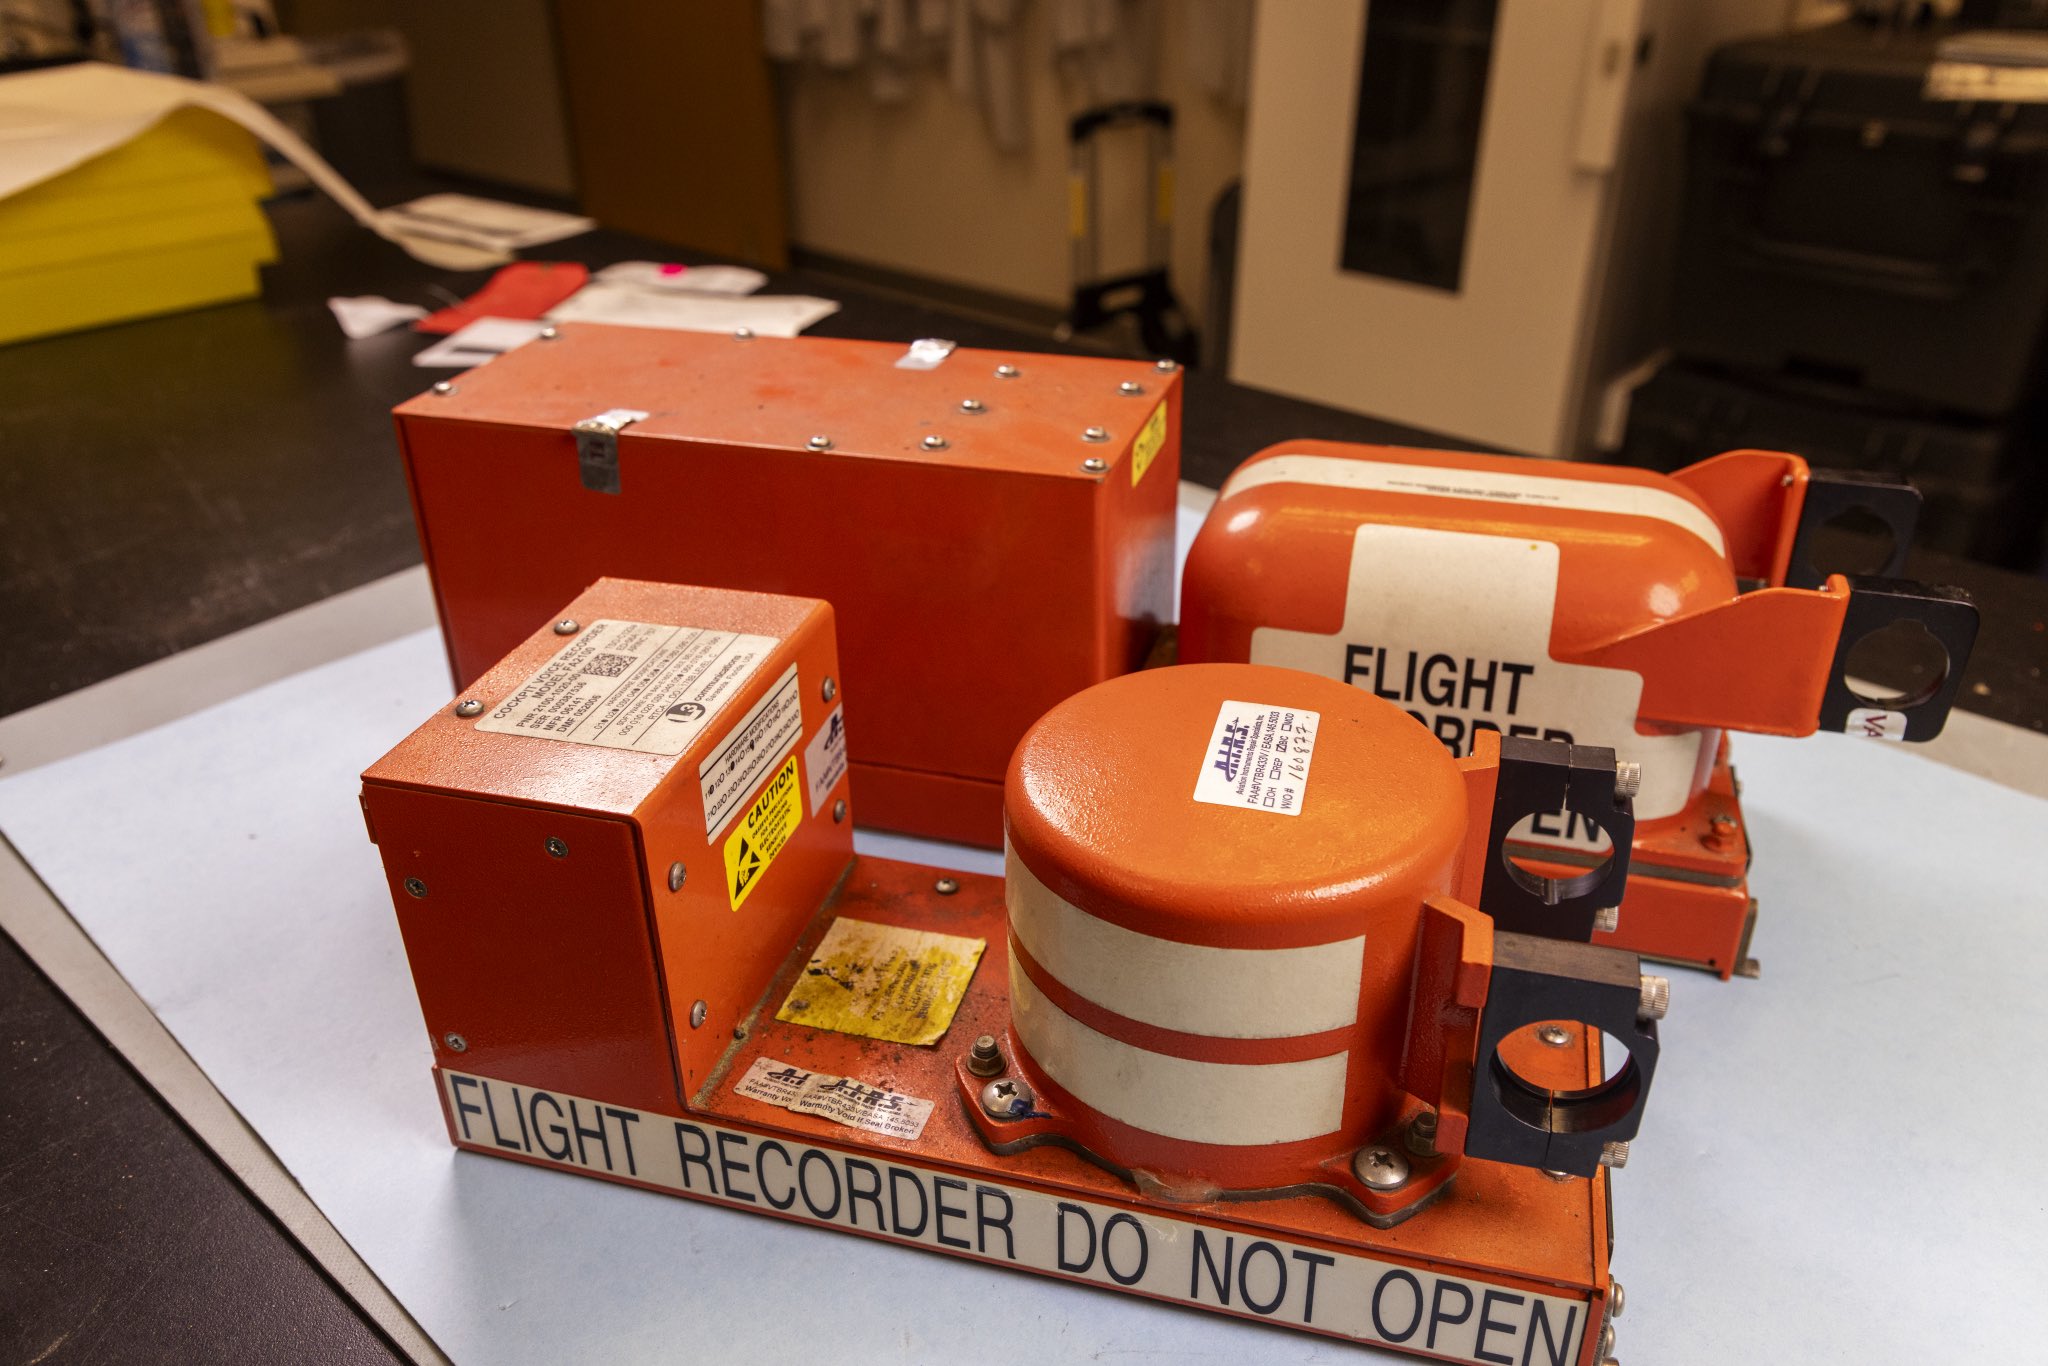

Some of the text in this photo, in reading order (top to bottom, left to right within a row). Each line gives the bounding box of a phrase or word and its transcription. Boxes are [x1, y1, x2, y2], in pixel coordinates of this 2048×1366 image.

[493, 624, 604, 719] COCKPIT VOICE RECORDER
[531, 647, 595, 698] MODEL FA2100
[694, 655, 741, 701] communications
[1344, 644, 1534, 715] FLIGHT
[516, 713, 537, 727] PNR
[529, 715, 550, 728] SER
[542, 715, 564, 730] MFR
[556, 717, 575, 732] DMF
[725, 700, 779, 763] HARDWARE MODIFICATIONS
[1247, 739, 1257, 751] Repair
[1240, 751, 1254, 776] Instruments
[1266, 786, 1276, 797] OH
[1272, 757, 1282, 770] REP
[748, 760, 794, 828] CAUTION
[1235, 776, 1247, 795] Aviation
[1531, 809, 1600, 842] EN
[745, 1085, 779, 1100] Warranty
[837, 1108, 855, 1120] Void
[865, 1119, 882, 1127] Seal
[885, 1124, 914, 1134] Broken
[449, 1074, 1581, 1366] FLIGHT RECORDER DO NOT OPEN
